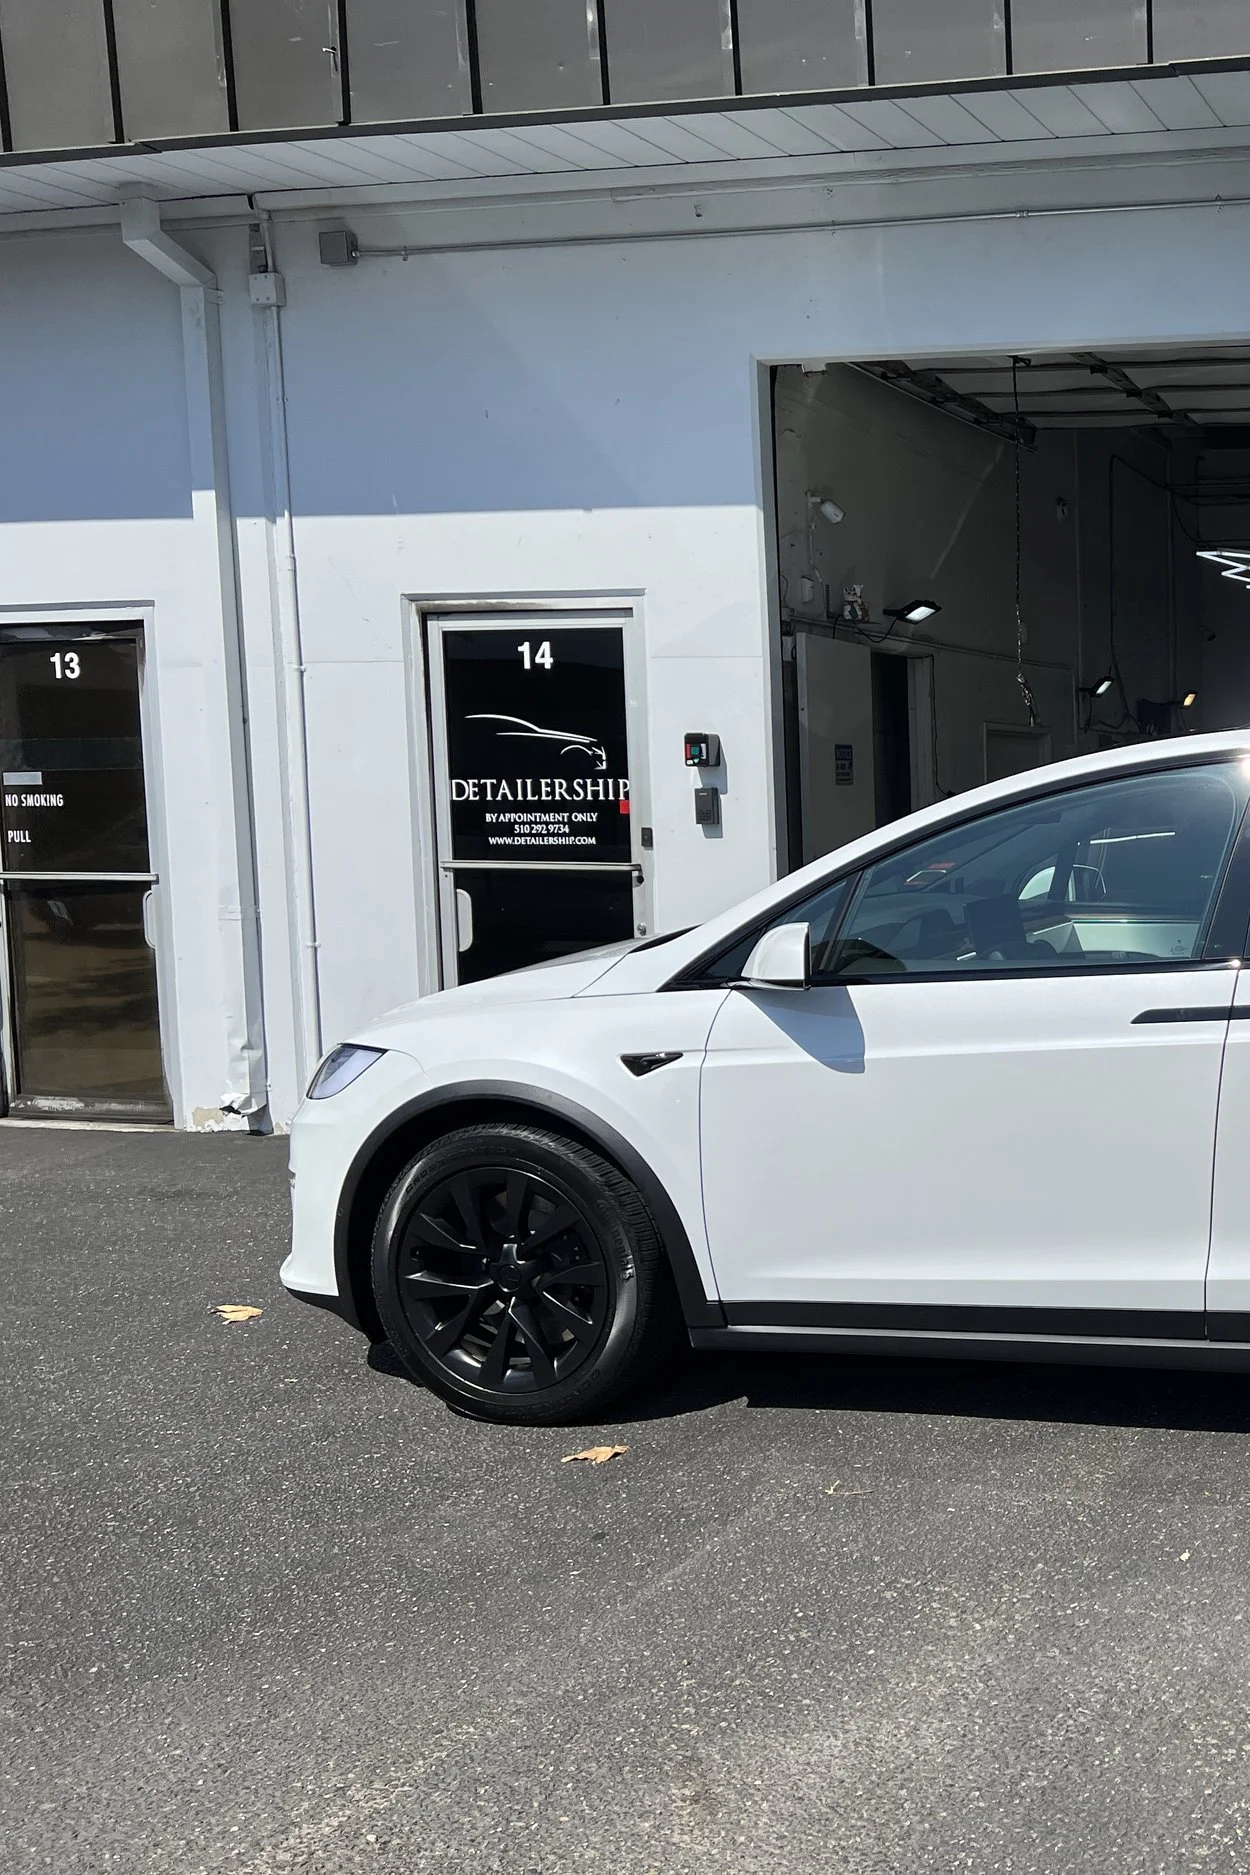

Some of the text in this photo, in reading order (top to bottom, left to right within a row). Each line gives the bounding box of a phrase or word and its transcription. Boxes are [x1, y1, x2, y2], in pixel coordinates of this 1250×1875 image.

[517, 641, 554, 670] 14
[49, 651, 81, 680] 13
[450, 778, 631, 801] DETAILERSHIP
[5, 793, 64, 807] NO SMOKING
[485, 812, 598, 823] BY APPOINTMENT ONLY
[514, 824, 570, 834] 510 292 9734
[7, 830, 32, 843] PULL
[488, 836, 597, 846] WWW.DETAILERSHIP.COM
